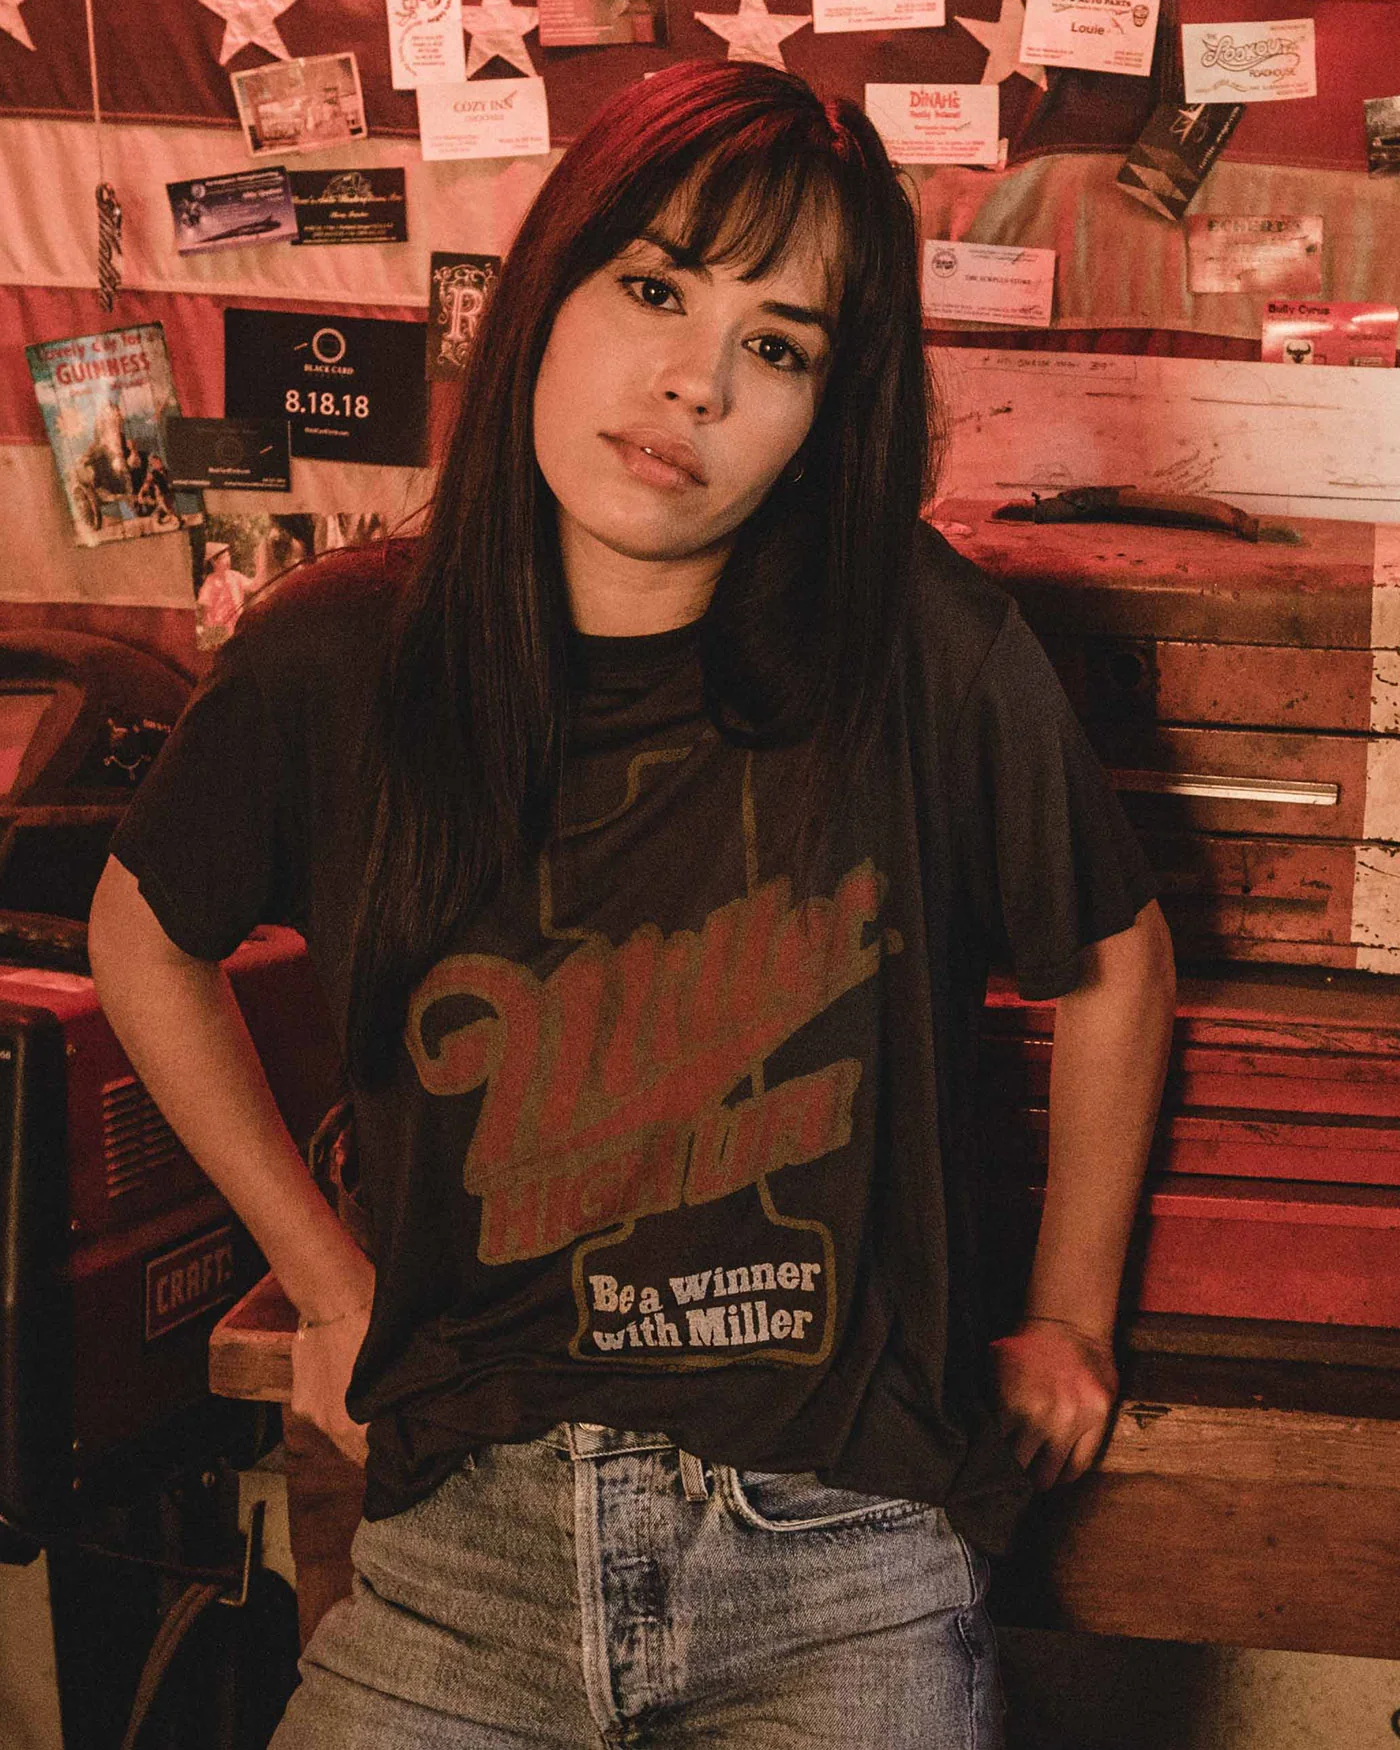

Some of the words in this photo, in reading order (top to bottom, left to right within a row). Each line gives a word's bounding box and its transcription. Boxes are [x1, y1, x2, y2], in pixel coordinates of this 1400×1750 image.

[1071, 22, 1105, 35] Louie
[453, 100, 486, 113] COZY
[55, 351, 151, 386] GUINNESS
[303, 363, 329, 373] BLACK
[331, 366, 355, 376] CARD
[285, 389, 370, 419] 8.18.18
[406, 857, 904, 1195] Miller
[588, 1274, 635, 1315] Be
[638, 1286, 664, 1315] a
[592, 1312, 683, 1352] with
[685, 1300, 814, 1347] Miller
